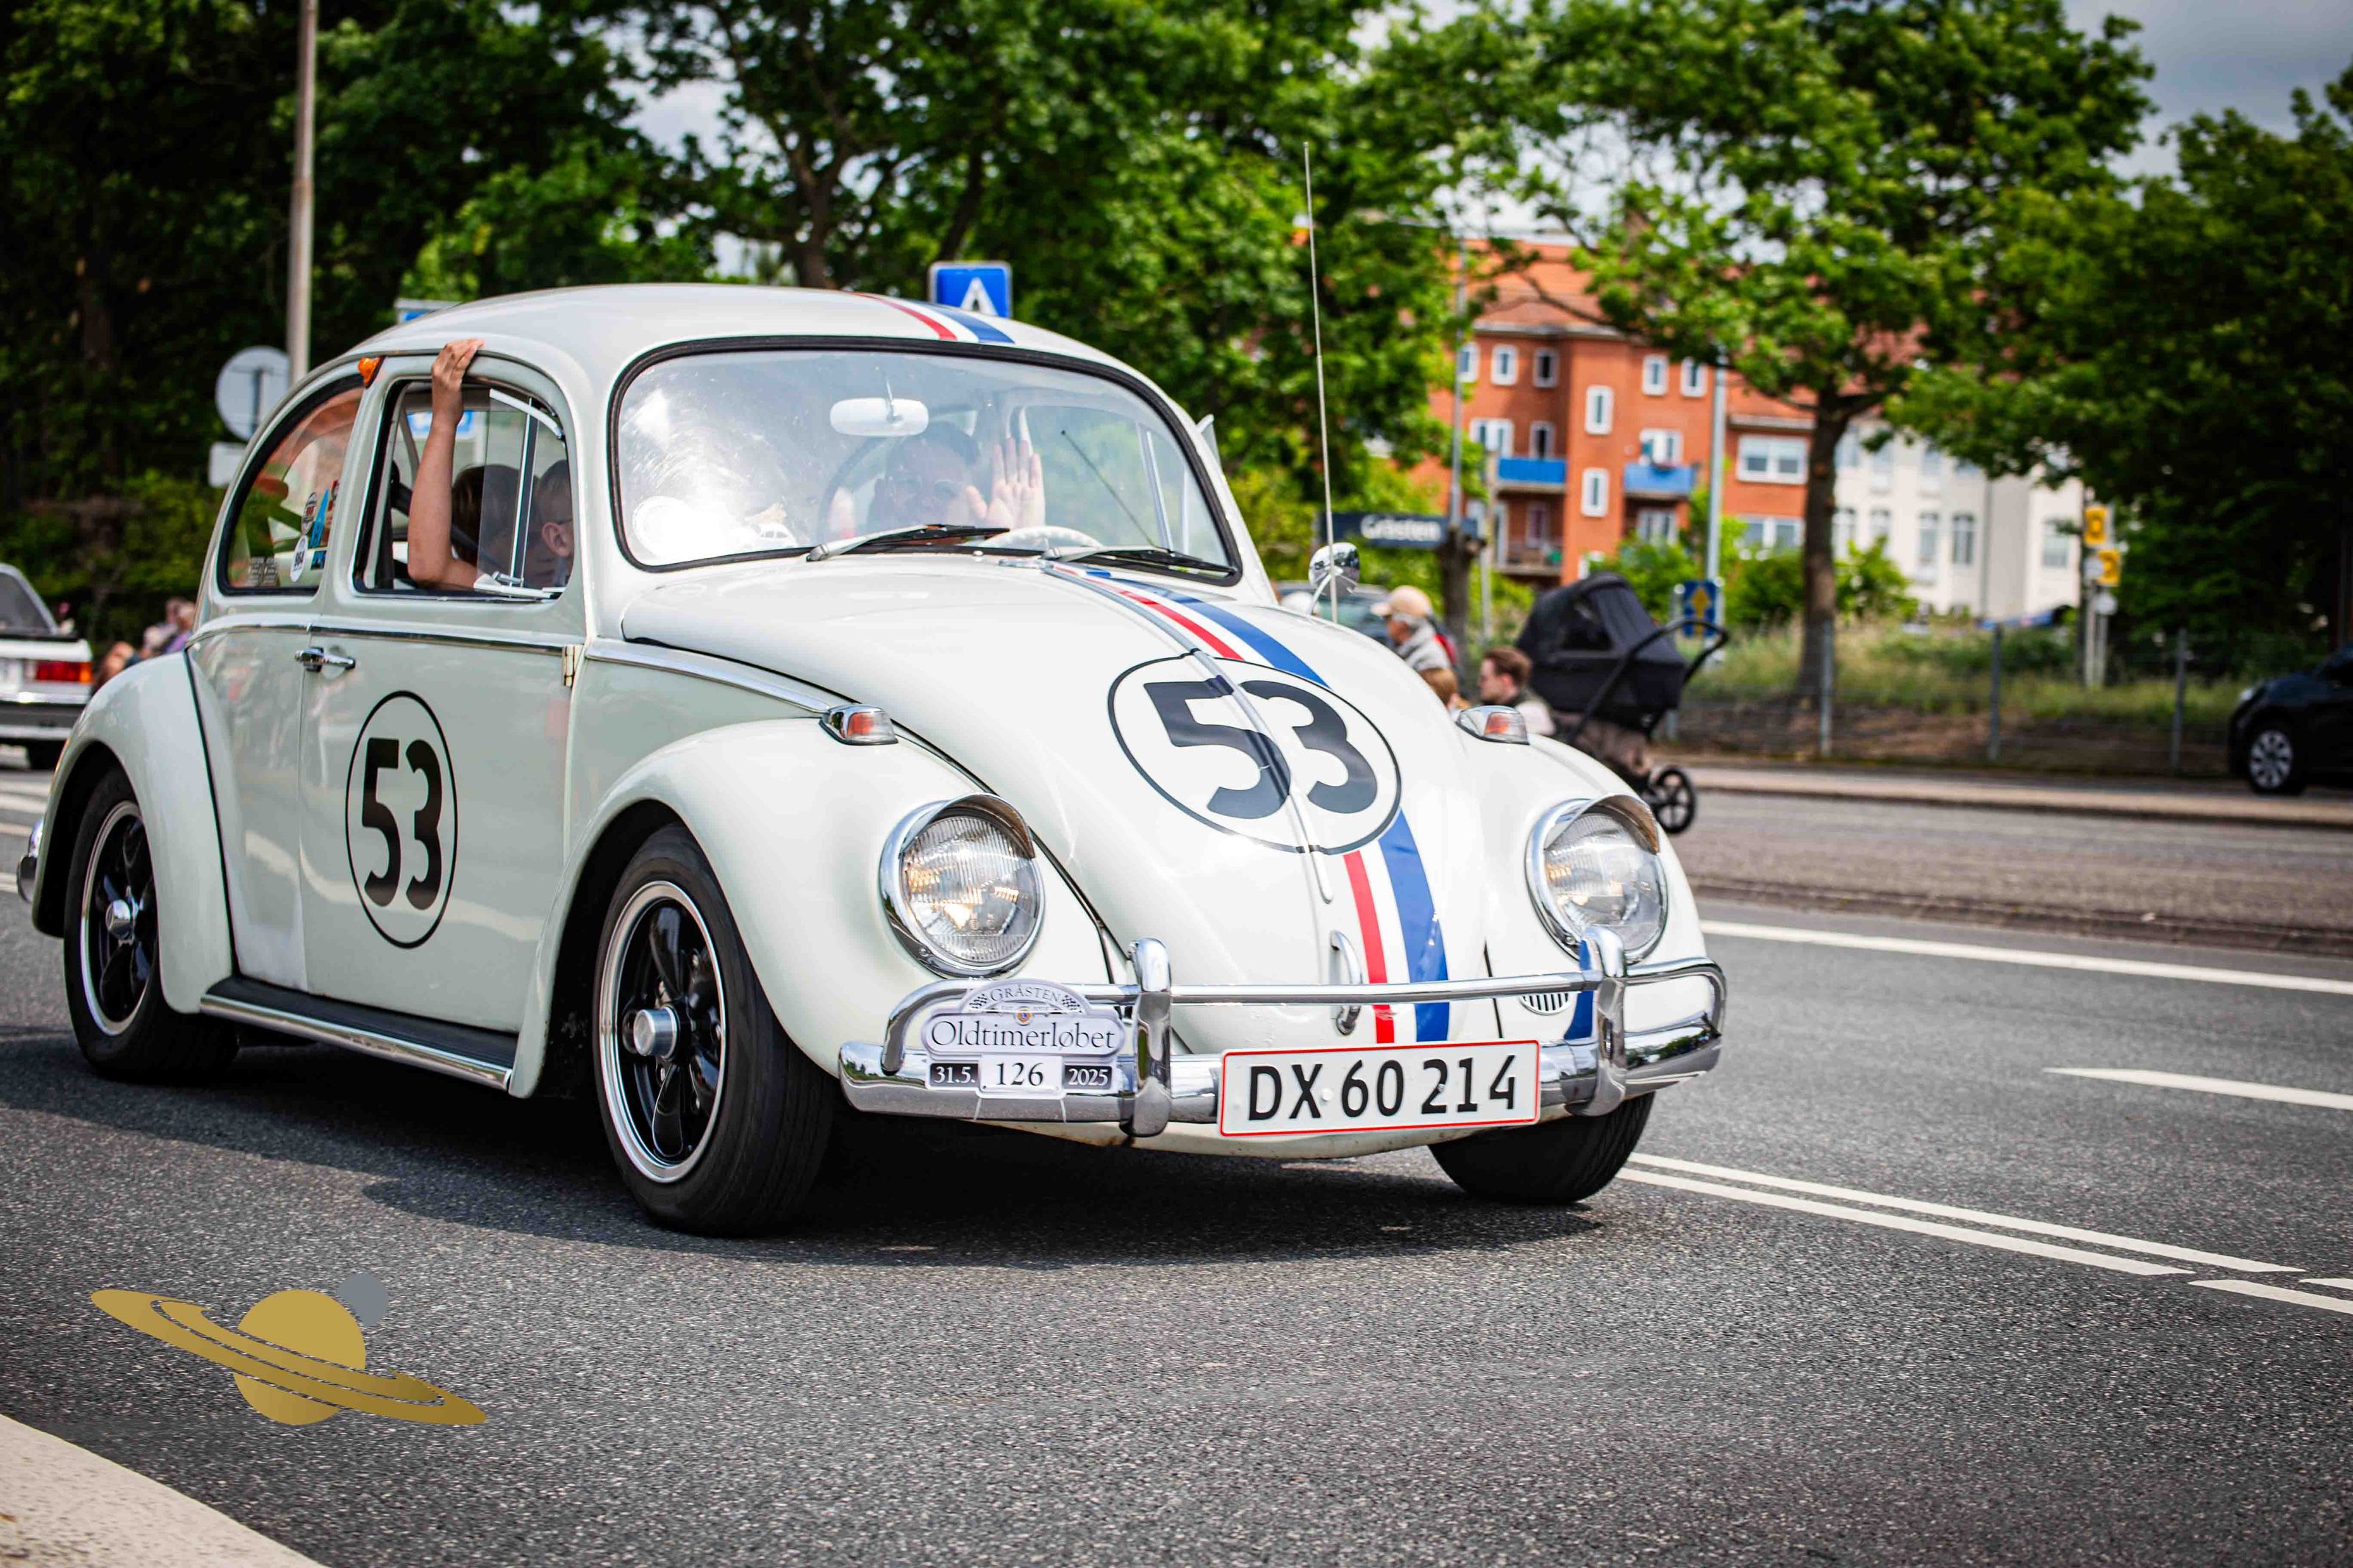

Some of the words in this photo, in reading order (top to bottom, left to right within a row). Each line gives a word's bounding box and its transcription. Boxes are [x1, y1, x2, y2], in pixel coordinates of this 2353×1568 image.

[1143, 675, 1377, 819] 53
[361, 737, 442, 910] 53
[990, 984, 1060, 1002] GRÅSTEN
[931, 1020, 1115, 1050] Oldtimerløbet
[996, 1062, 1043, 1086] 126
[1068, 1068, 1109, 1086] 2025
[1248, 1063, 1323, 1121] DX
[1341, 1059, 1404, 1117] 60
[1421, 1054, 1515, 1114] 214
